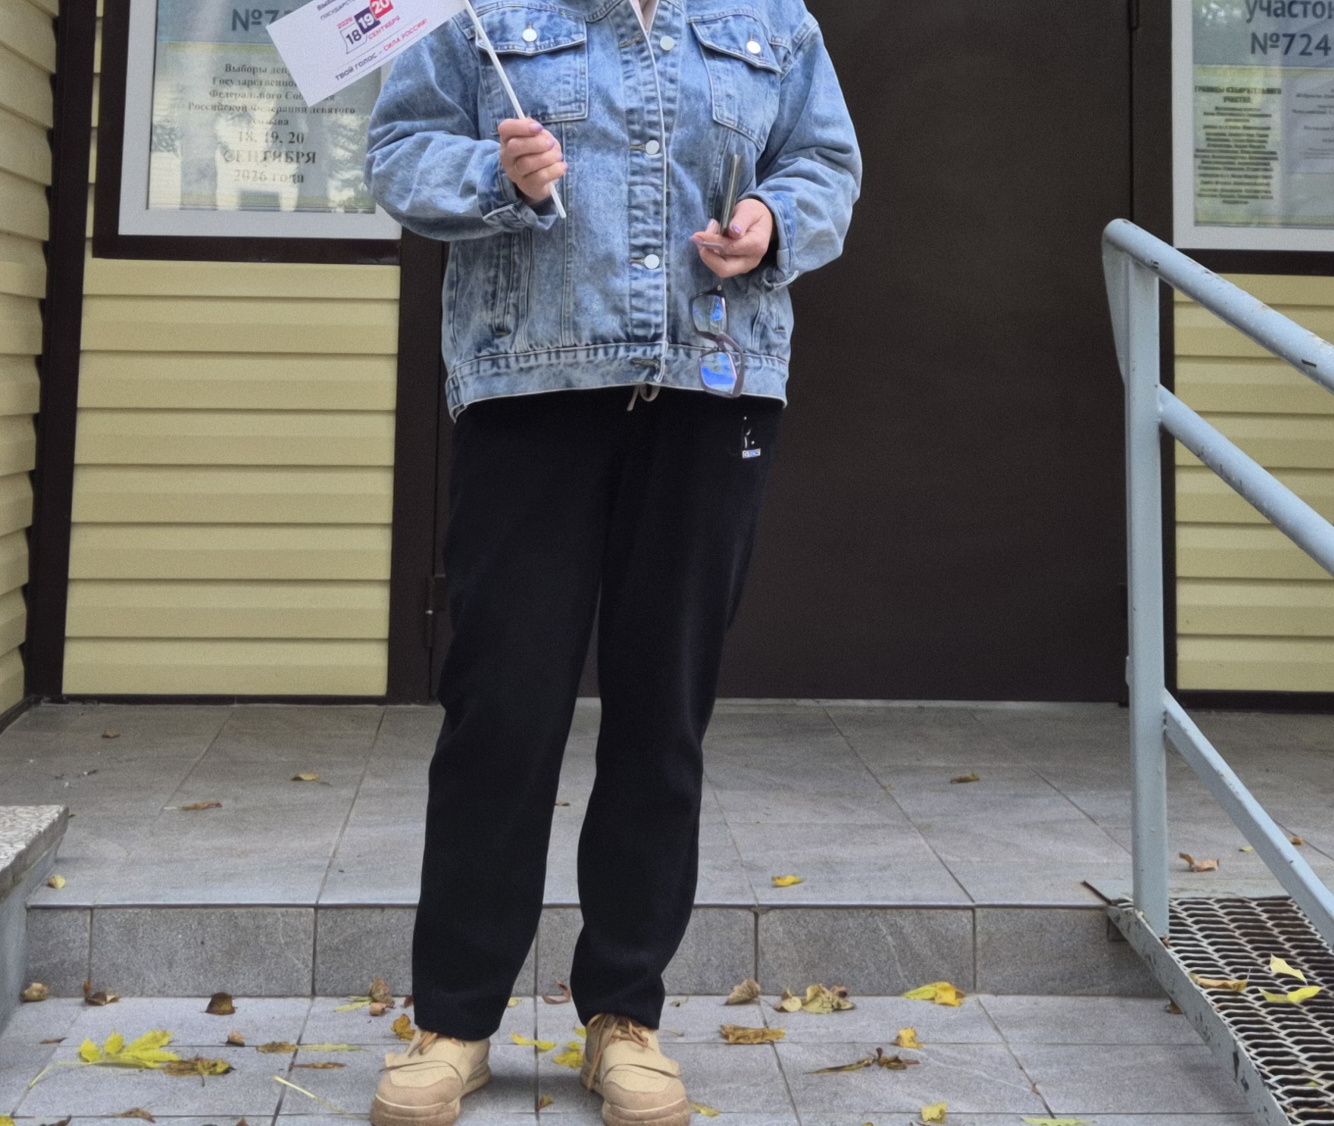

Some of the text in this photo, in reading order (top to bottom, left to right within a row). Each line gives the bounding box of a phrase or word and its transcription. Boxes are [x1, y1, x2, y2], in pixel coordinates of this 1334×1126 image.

[346, 29, 362, 45] 18
[357, 12, 375, 30] 19
[1250, 31, 1332, 57] №724
[335, 64, 355, 81] ТВОЙ
[355, 52, 378, 70] ГОЛОС
[288, 131, 305, 144] 20
